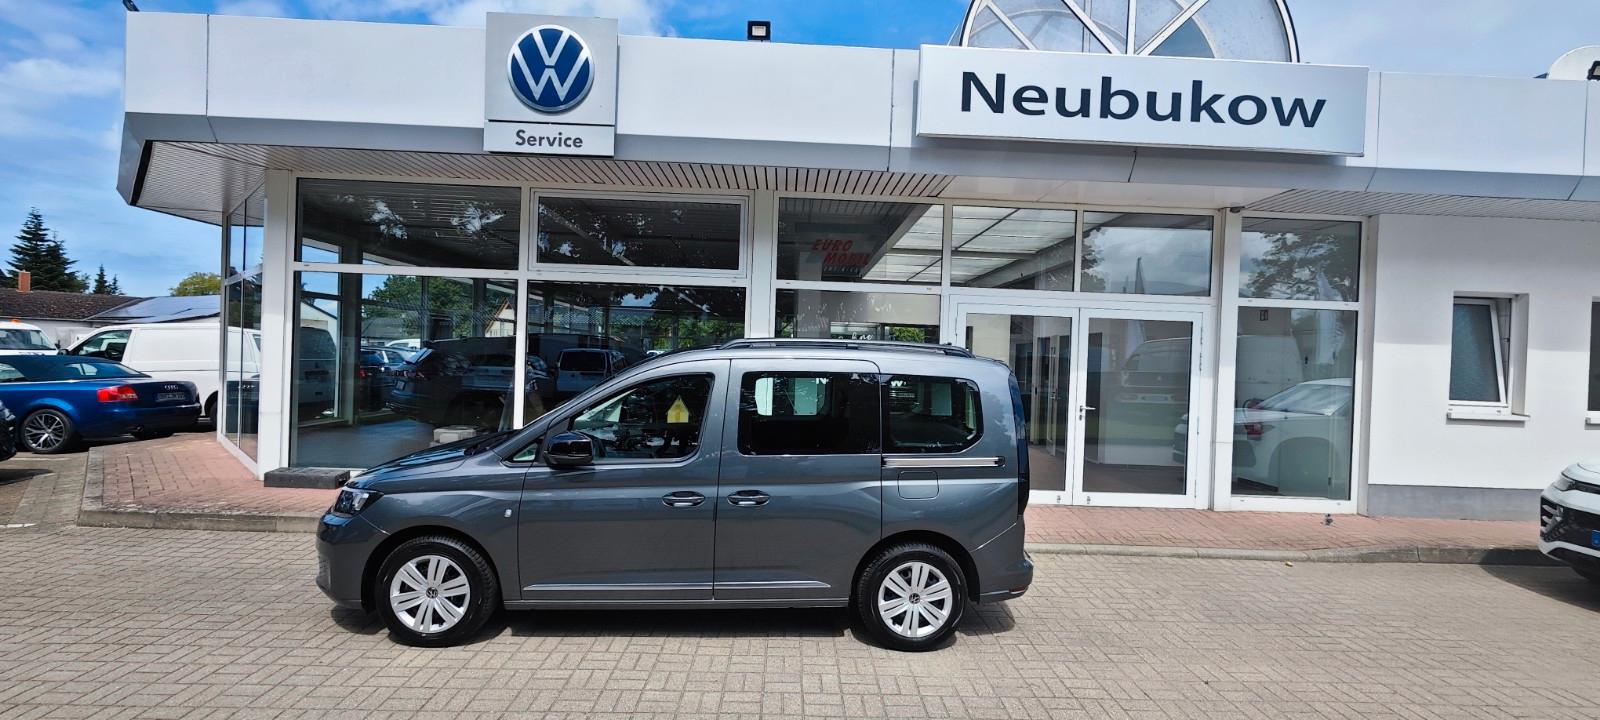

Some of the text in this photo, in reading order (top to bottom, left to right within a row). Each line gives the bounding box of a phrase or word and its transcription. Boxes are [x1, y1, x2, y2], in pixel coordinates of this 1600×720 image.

[960, 71, 1327, 128] Neubukow
[515, 129, 583, 148] Service
[812, 239, 853, 252] EURO
